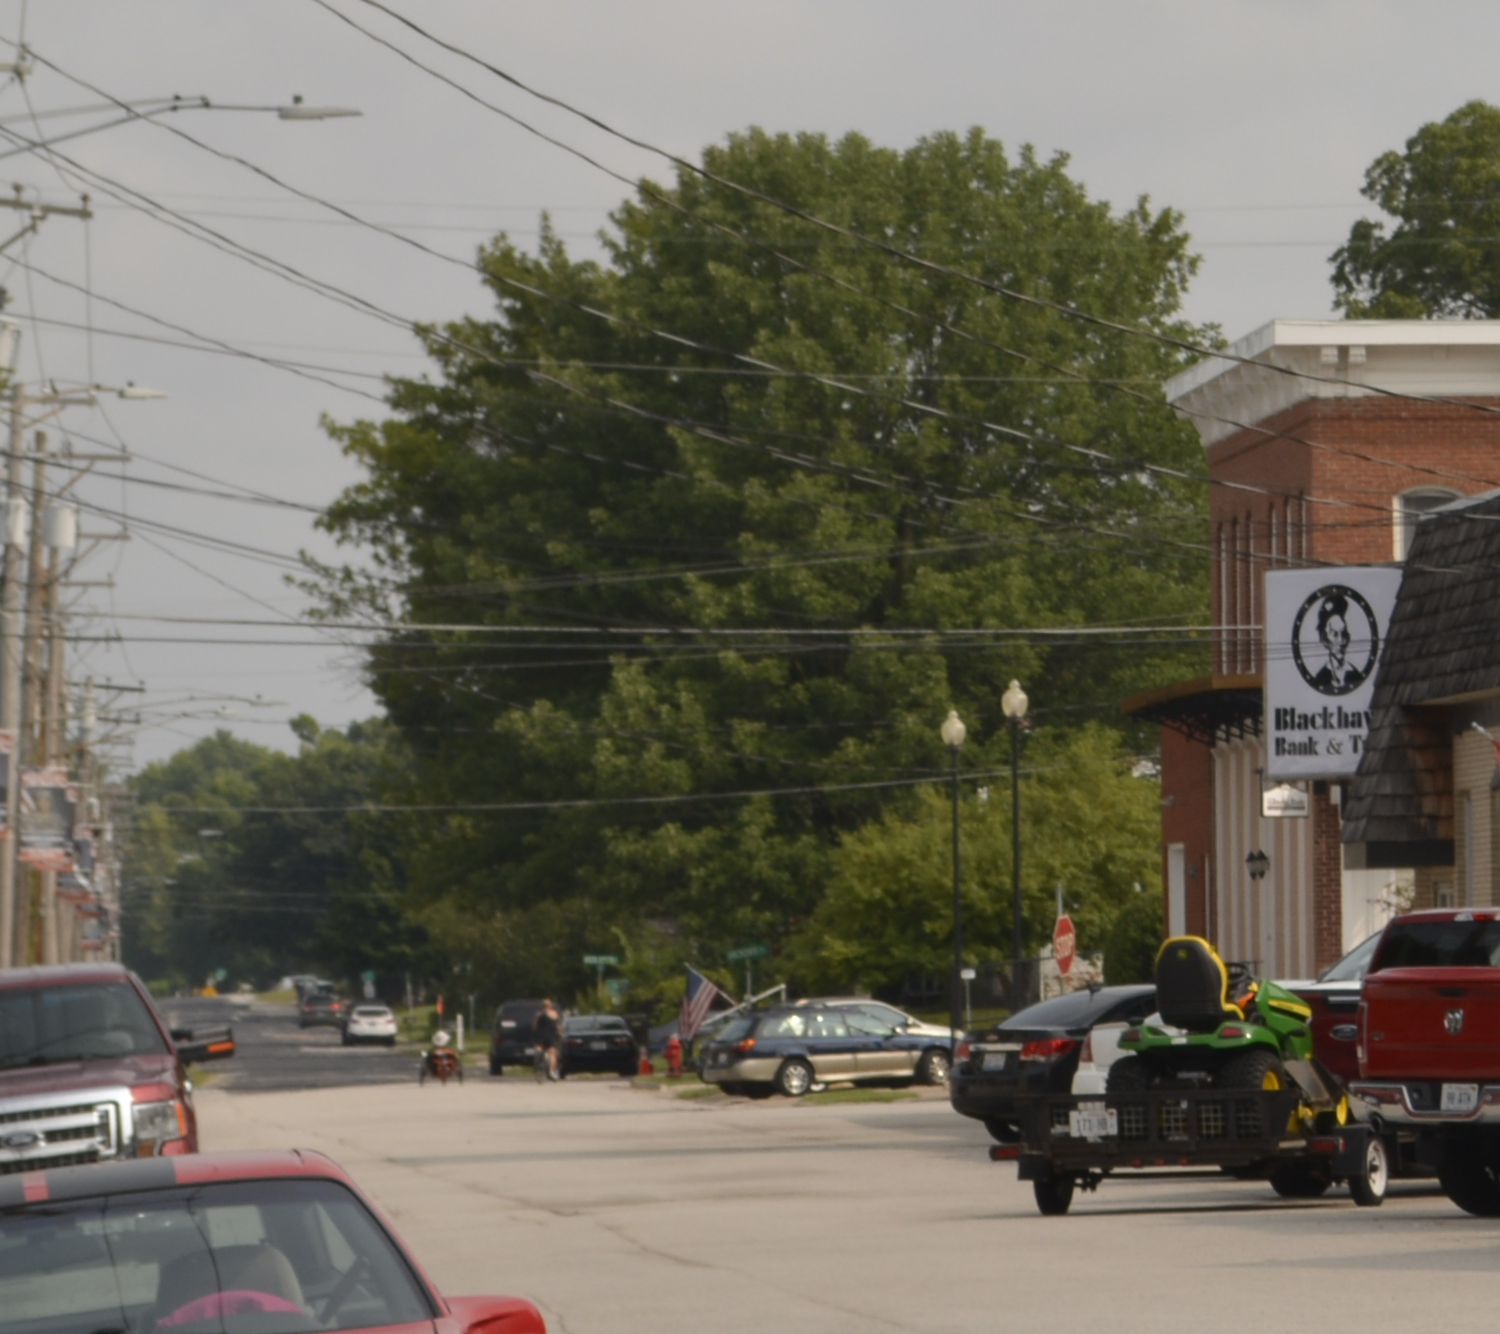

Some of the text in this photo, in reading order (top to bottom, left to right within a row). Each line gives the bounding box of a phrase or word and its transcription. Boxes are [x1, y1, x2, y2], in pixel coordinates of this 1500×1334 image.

[1274, 705, 1373, 732] Blackha
[1274, 736, 1320, 756] Bank
[1326, 738, 1344, 754] &
